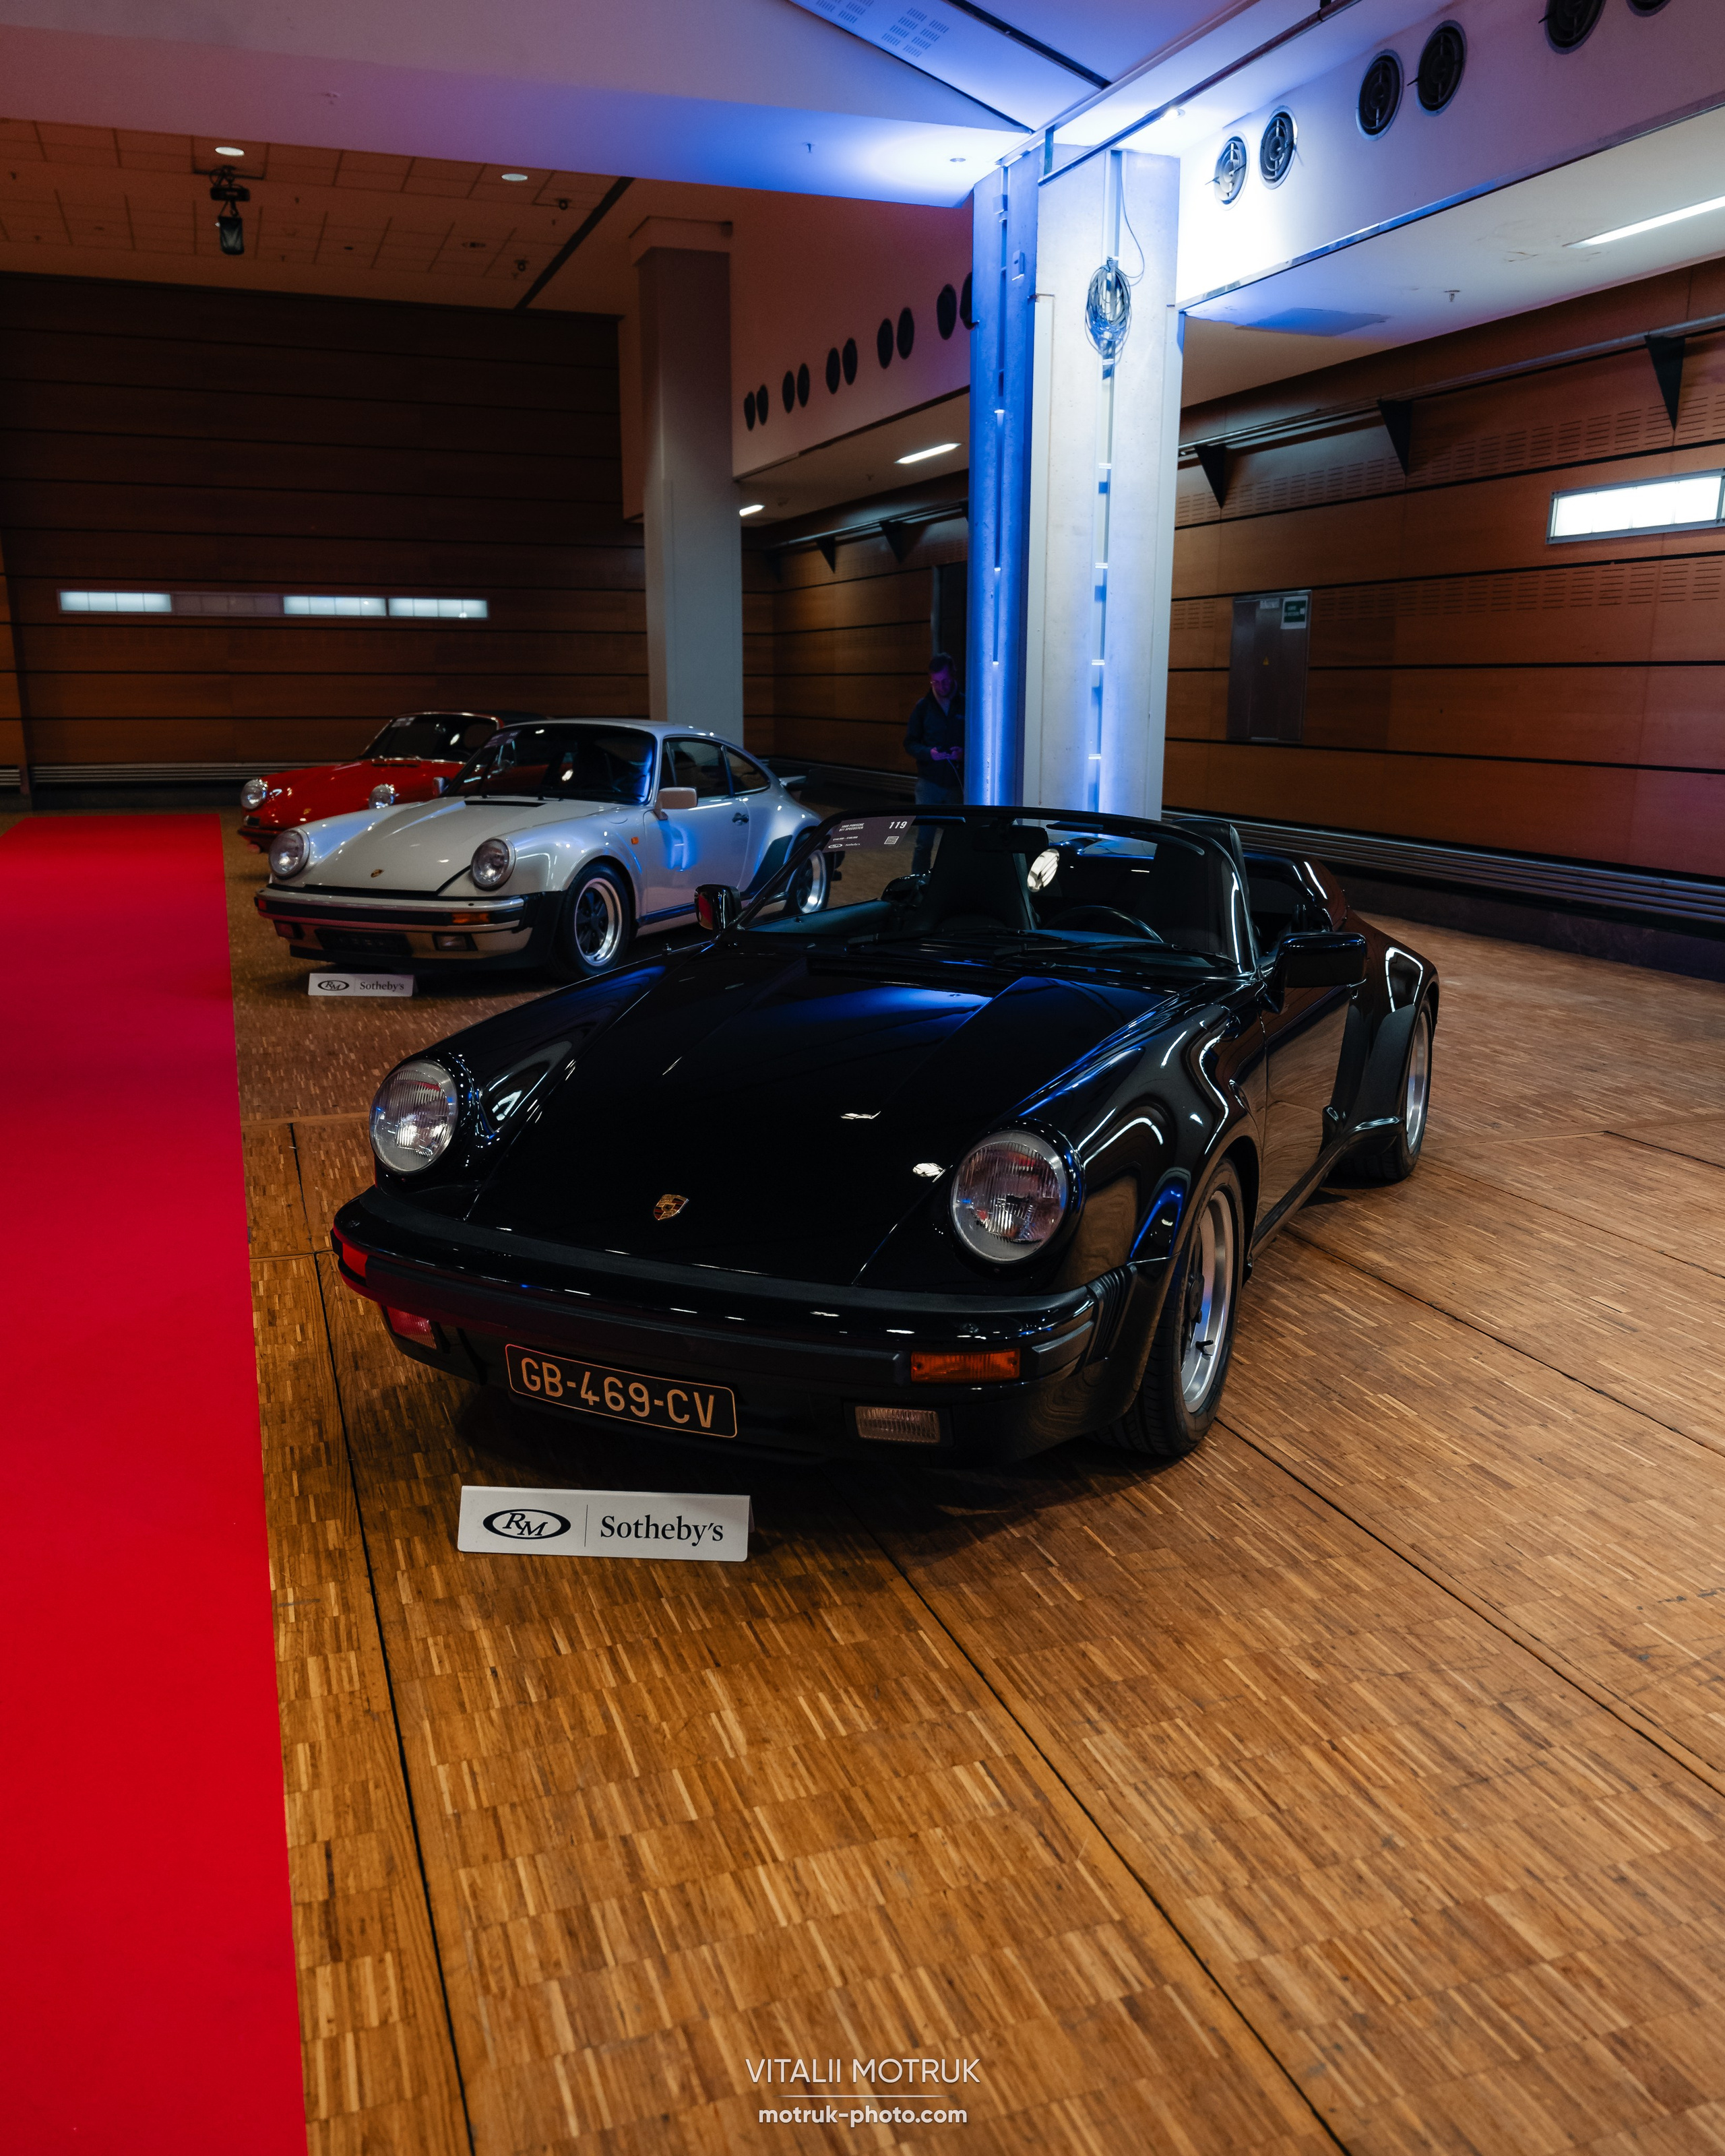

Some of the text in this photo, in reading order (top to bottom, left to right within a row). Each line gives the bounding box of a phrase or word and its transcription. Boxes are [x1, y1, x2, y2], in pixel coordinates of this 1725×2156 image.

[889, 821, 908, 829] 119
[359, 981, 405, 992] Sotheby's
[521, 1357, 714, 1428] GB-469-CV
[600, 1514, 724, 1547] Sotheby's
